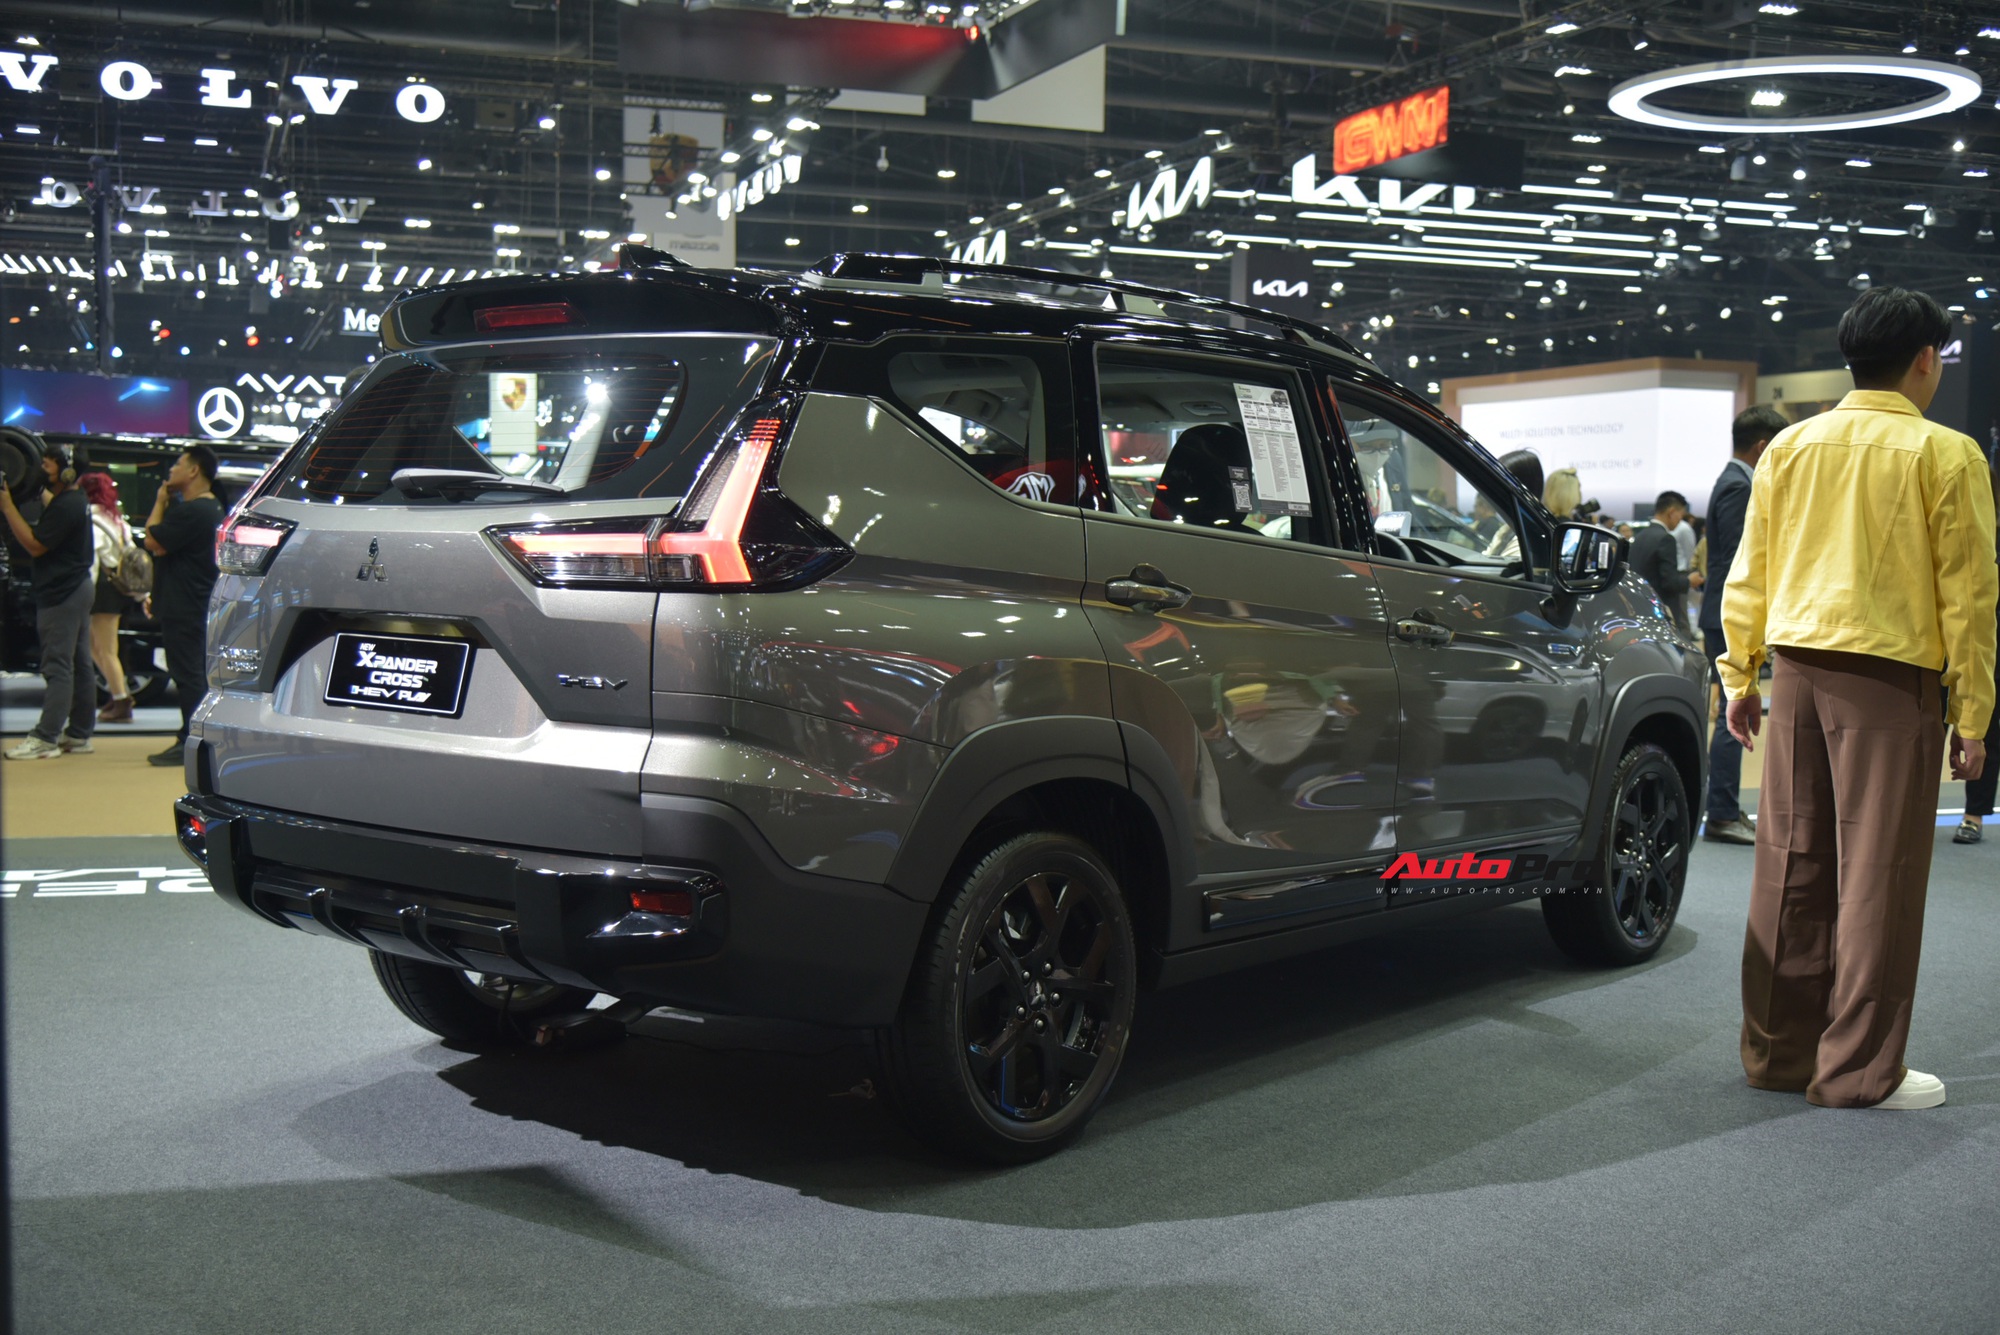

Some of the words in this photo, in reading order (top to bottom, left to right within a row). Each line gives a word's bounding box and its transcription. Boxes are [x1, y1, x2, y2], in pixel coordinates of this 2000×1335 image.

[0, 52, 445, 123] VOLVO
[1334, 86, 1449, 174] GWM
[1127, 156, 1211, 228] KIA
[1253, 279, 1308, 297] KIA
[360, 643, 376, 652] NEW
[356, 651, 438, 674] XPANDER
[370, 671, 424, 688] CROSS
[351, 685, 397, 698] HEV
[398, 690, 431, 702] PLAY
